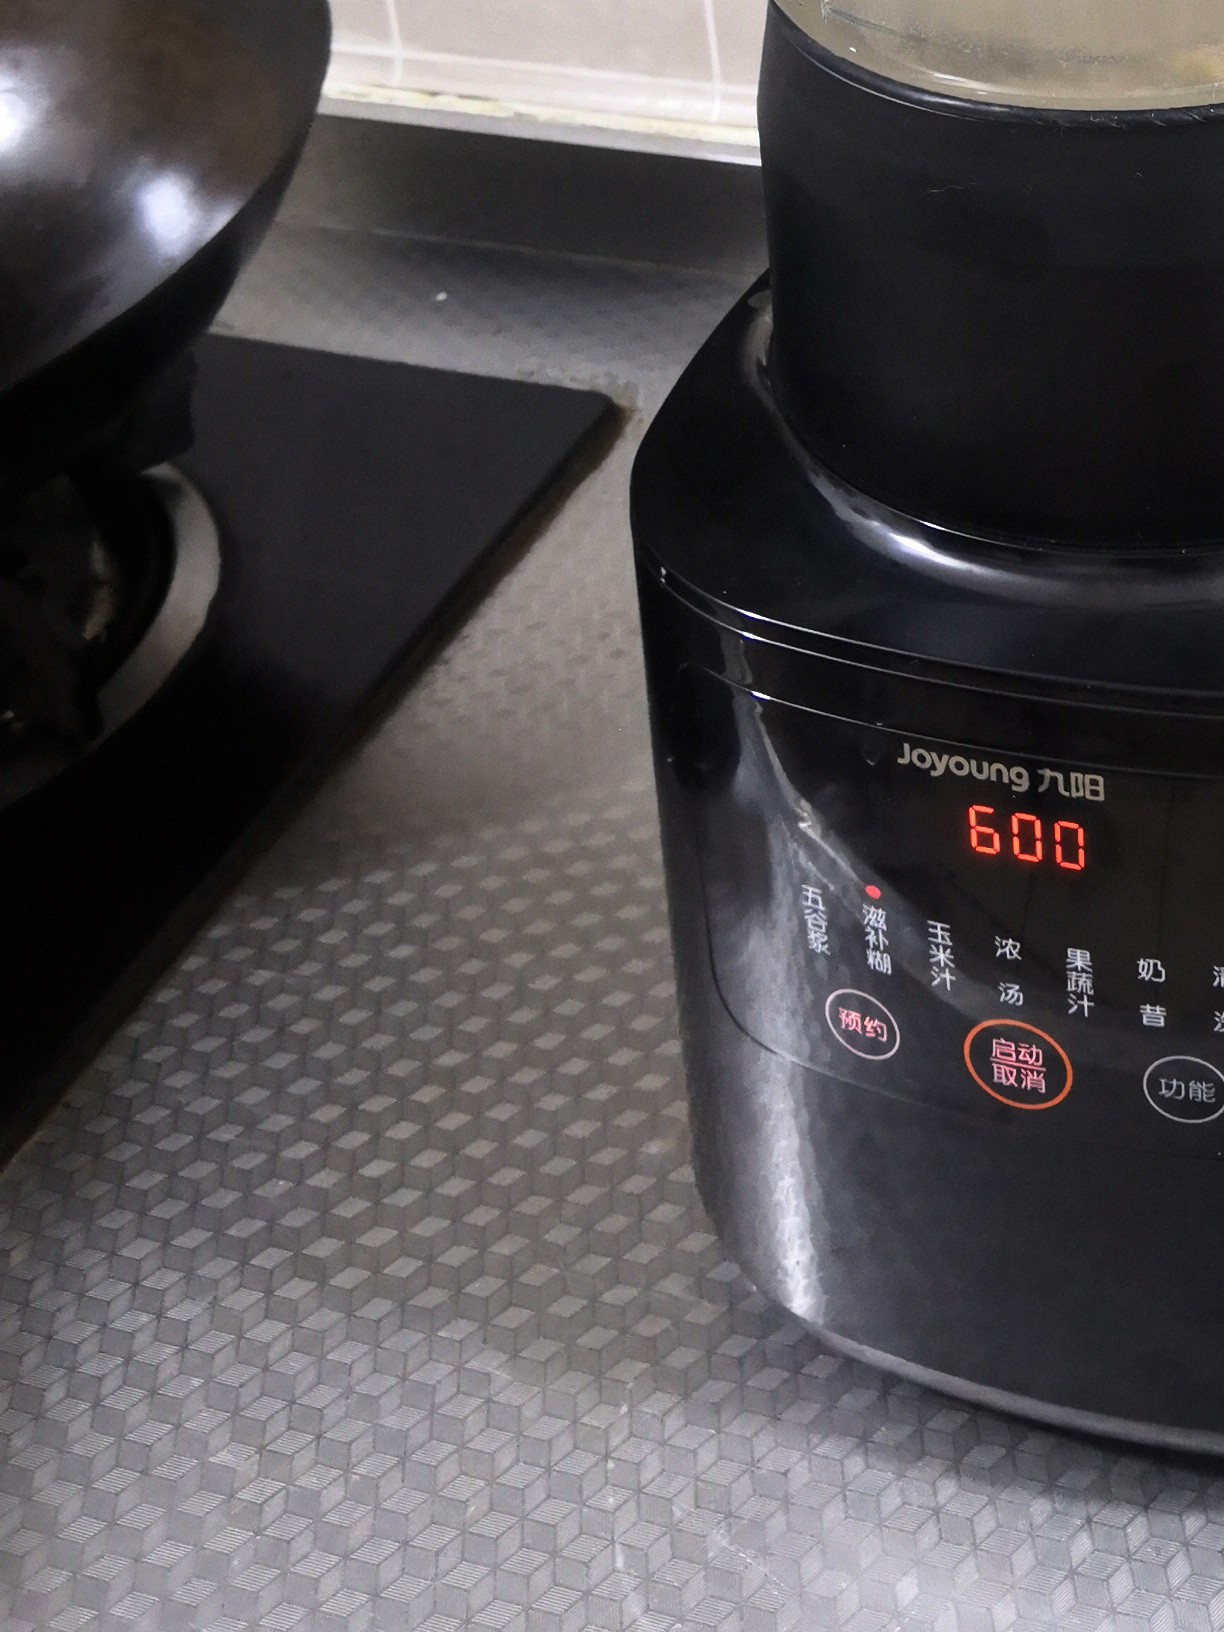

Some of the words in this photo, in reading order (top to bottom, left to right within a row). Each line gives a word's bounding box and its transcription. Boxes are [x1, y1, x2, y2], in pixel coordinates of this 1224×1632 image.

[897, 743, 1029, 793] Joyoung
[1036, 768, 1106, 803] 九阳
[968, 804, 1086, 871] 600
[862, 903, 892, 976] 滋补糊
[927, 920, 957, 992] 玉米汁
[994, 935, 1024, 1006] 浓汤
[1065, 948, 1095, 1019] 果蔬汁
[1137, 958, 1167, 1028] 奶昔
[837, 1006, 889, 1044] 预约
[990, 1036, 1043, 1067] 启动
[992, 1063, 1047, 1094] 取消
[1158, 1079, 1217, 1104] 功能
